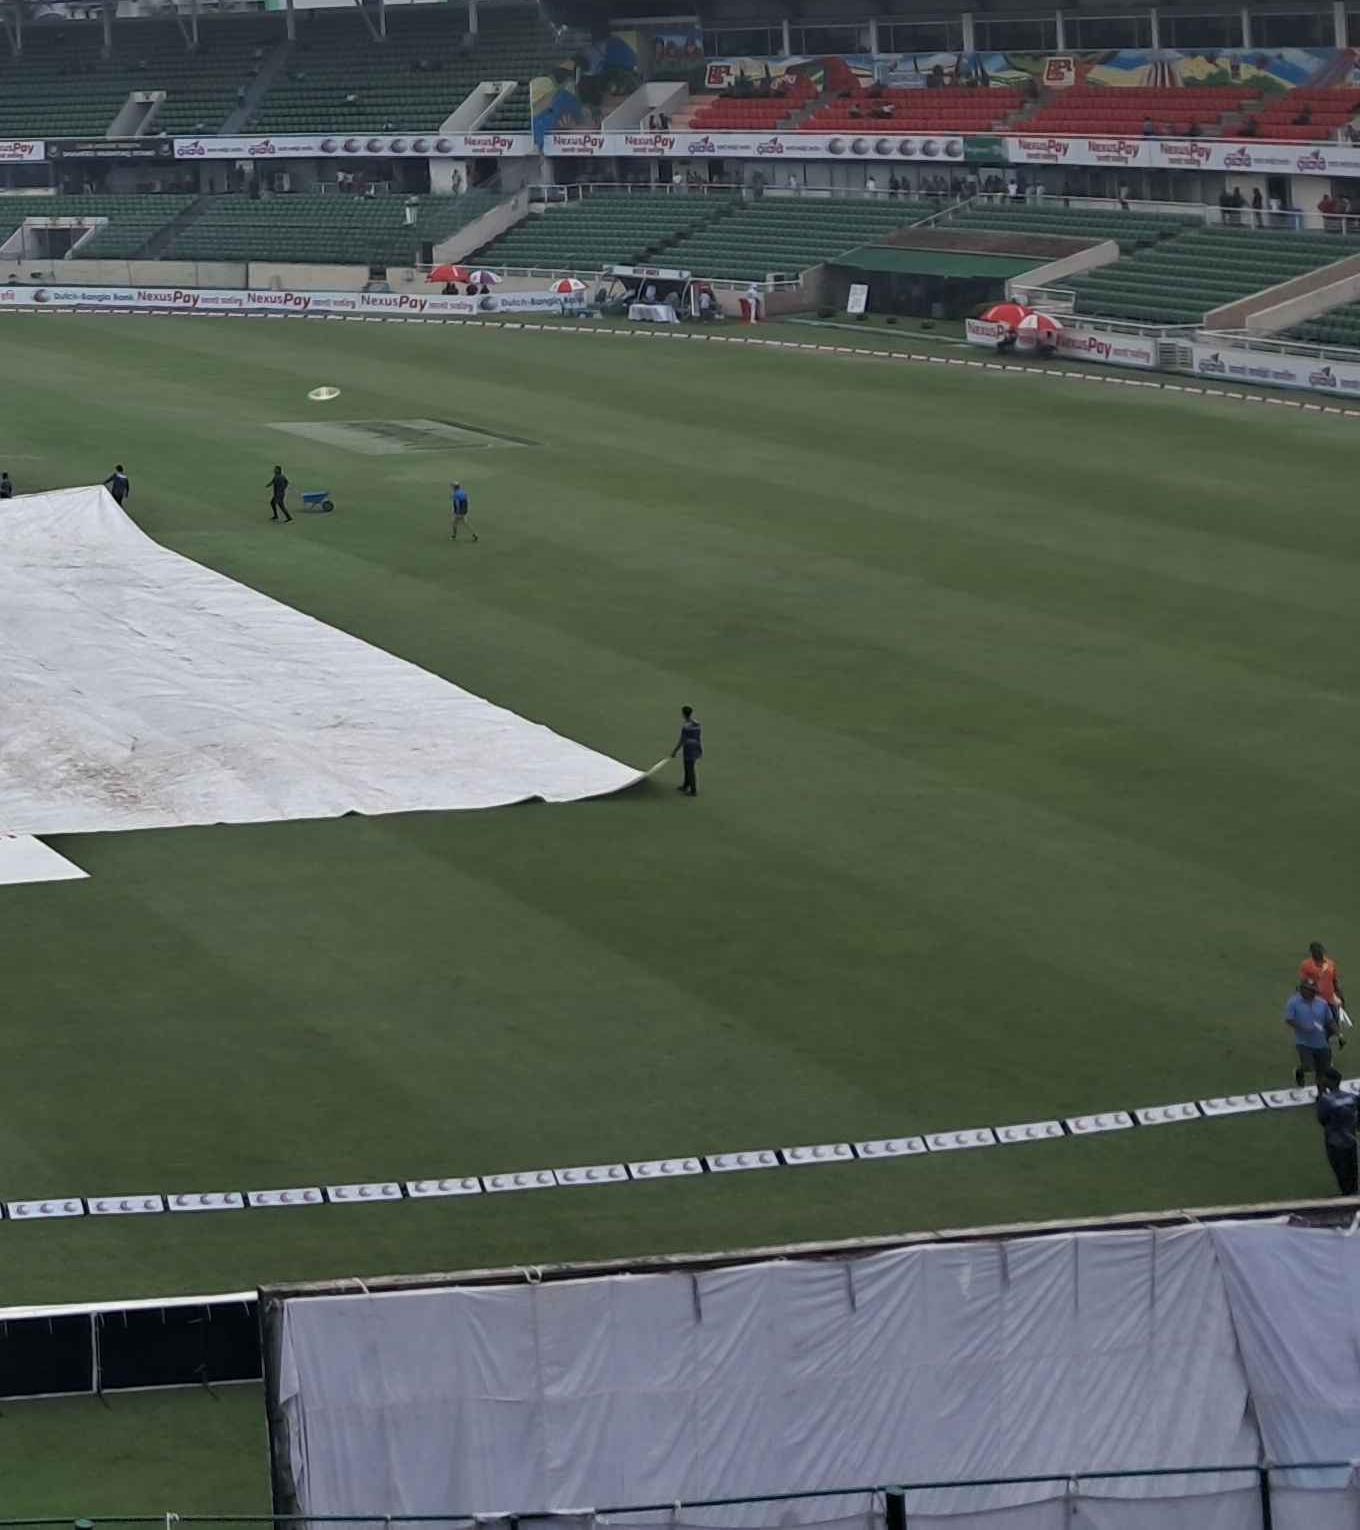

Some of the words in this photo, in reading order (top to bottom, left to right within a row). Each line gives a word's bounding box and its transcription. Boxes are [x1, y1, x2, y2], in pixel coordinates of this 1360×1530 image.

[553, 135, 605, 149] NexusPay
[624, 135, 676, 148] NexusPay
[1018, 139, 1070, 156] NexusPay
[1088, 141, 1140, 158] NexusPay
[1160, 143, 1212, 161] NexusPay
[137, 290, 200, 307] NexusPay
[247, 292, 311, 311] NexusPay
[360, 294, 428, 312] NexusPay
